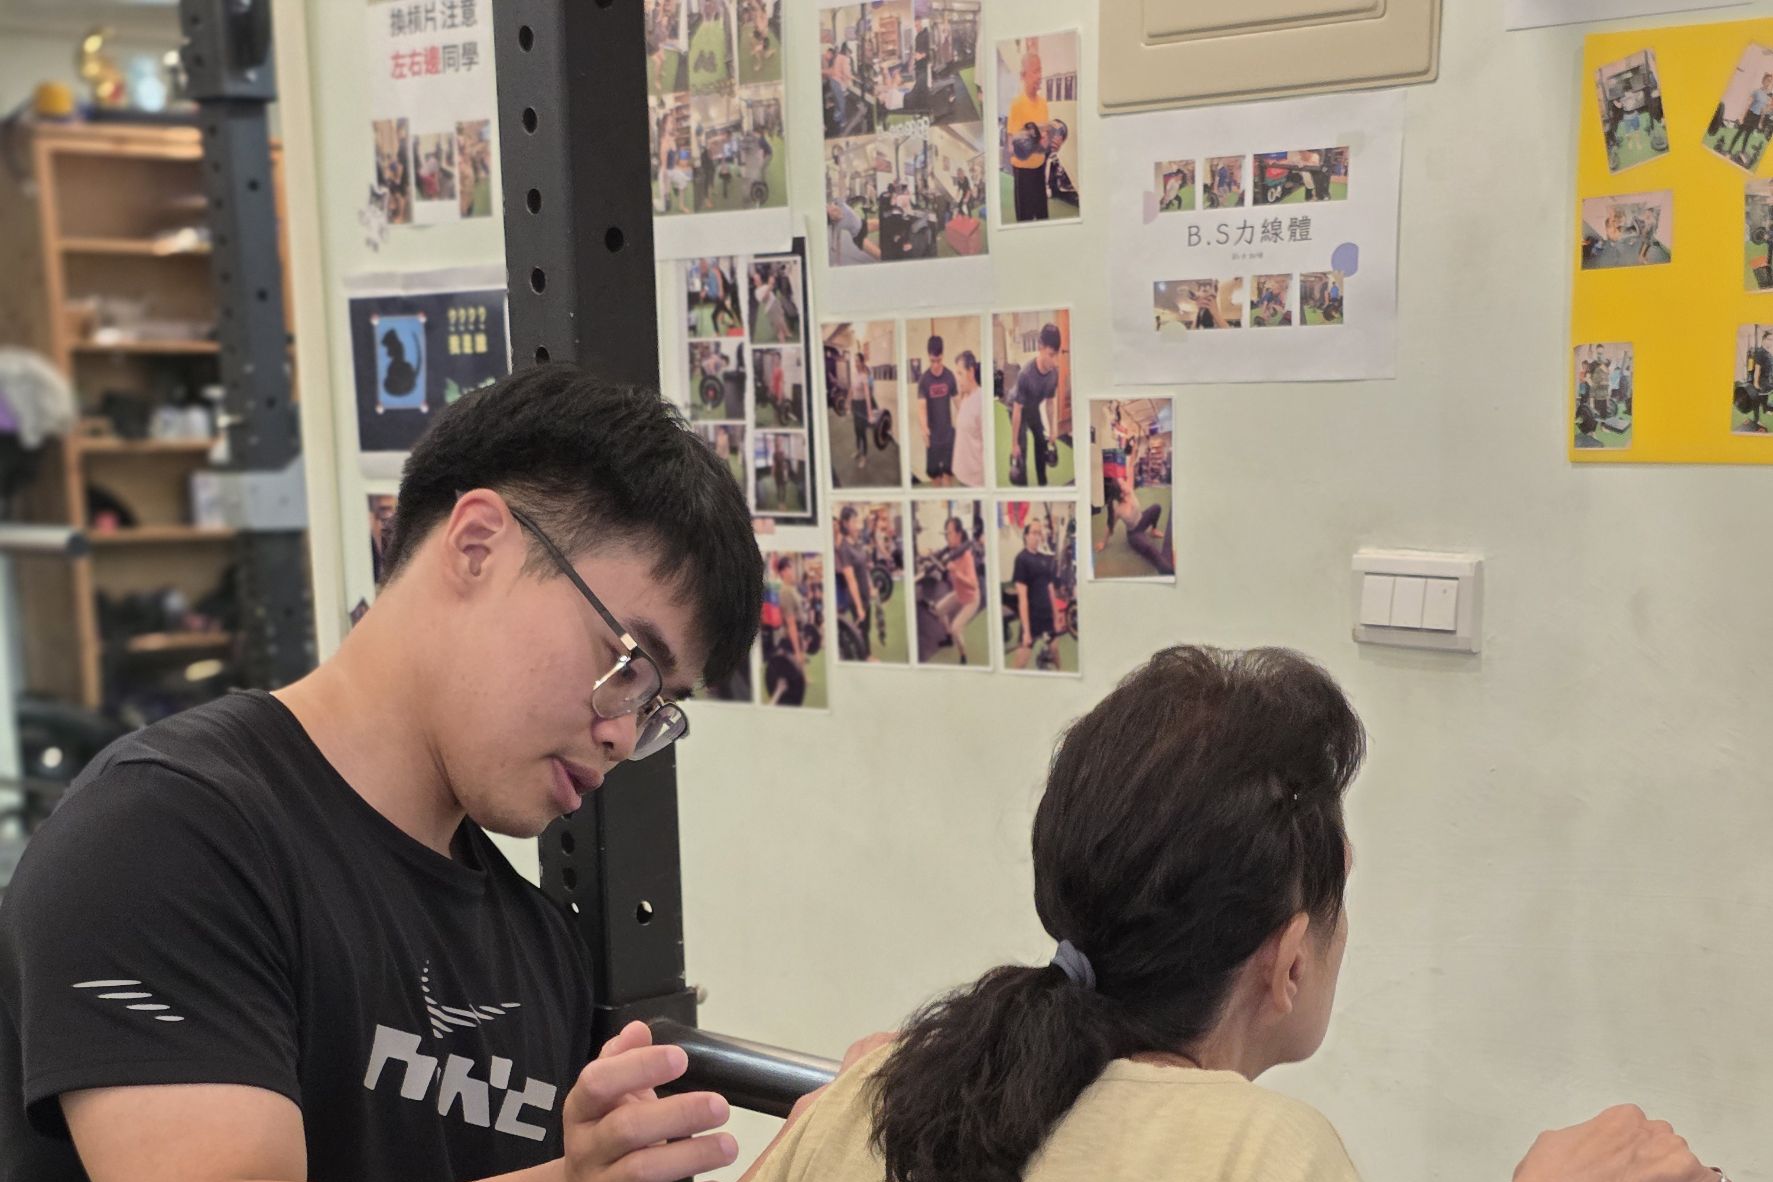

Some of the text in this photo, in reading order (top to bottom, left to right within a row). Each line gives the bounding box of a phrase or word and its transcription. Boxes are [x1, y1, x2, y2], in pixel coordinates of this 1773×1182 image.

[390, 42, 480, 79] 左右邊同學
[1187, 215, 1313, 247] B.S力線體
